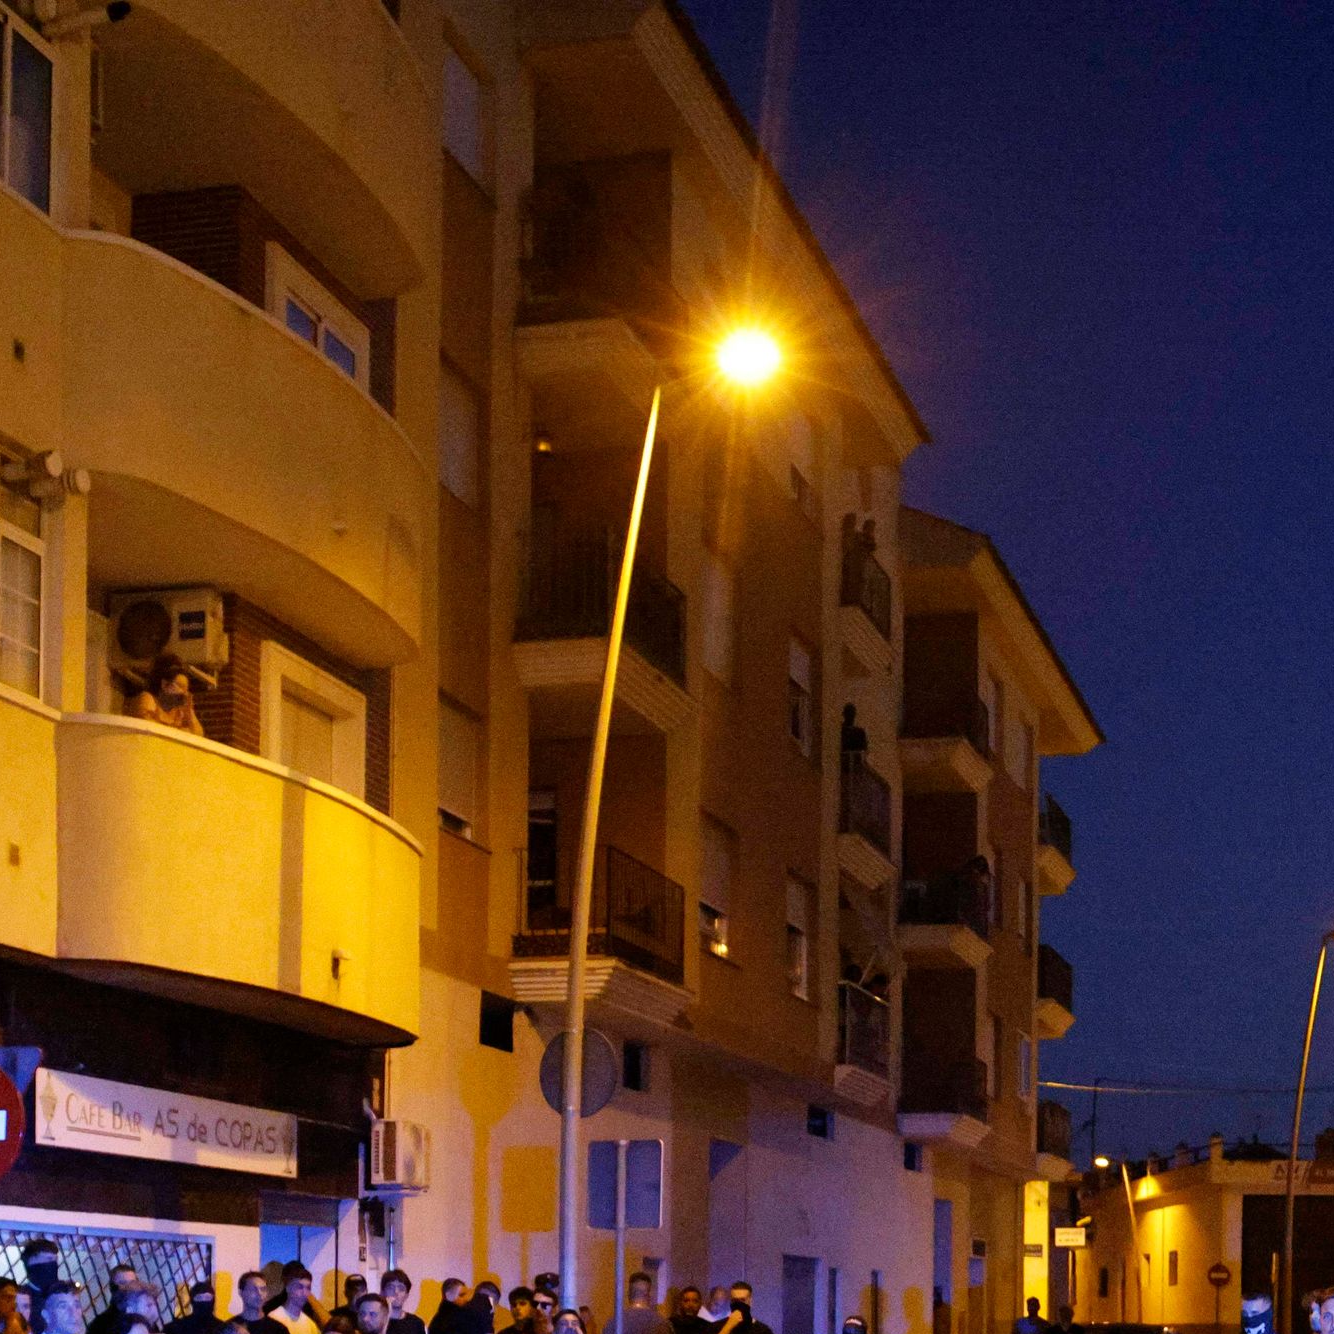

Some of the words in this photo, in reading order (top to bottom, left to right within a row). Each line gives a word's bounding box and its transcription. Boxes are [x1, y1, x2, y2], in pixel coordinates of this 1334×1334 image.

[152, 1108, 180, 1139] AS
[186, 1112, 208, 1144] de
[214, 1117, 276, 1154] COPAS
